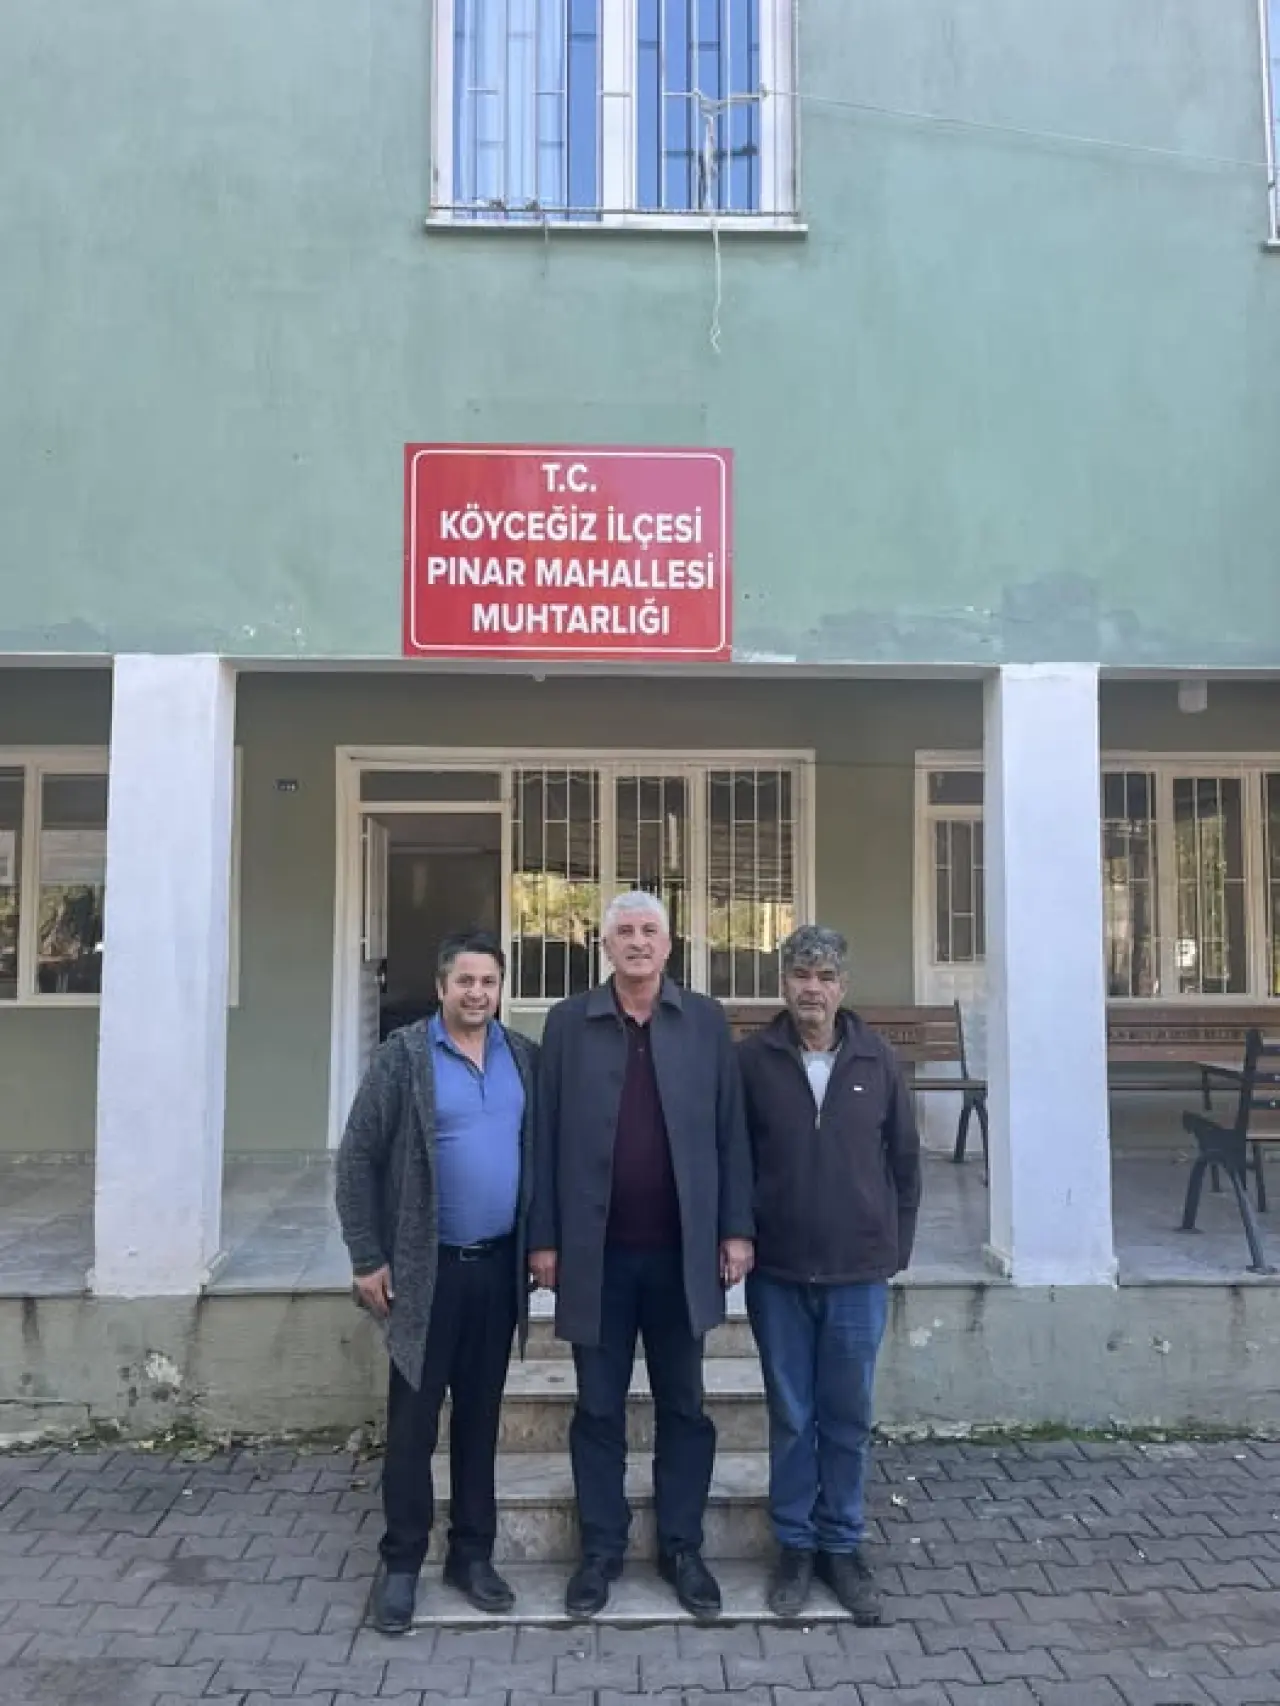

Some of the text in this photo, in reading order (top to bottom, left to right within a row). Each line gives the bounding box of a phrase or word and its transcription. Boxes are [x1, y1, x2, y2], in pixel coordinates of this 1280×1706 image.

[541, 463, 597, 493] T.C.
[440, 503, 702, 551] KÖYCEĞİZ İLÇESİ
[427, 552, 714, 590] PINAR MAHALLESİ
[472, 598, 670, 635] MUHTARLIĞI
